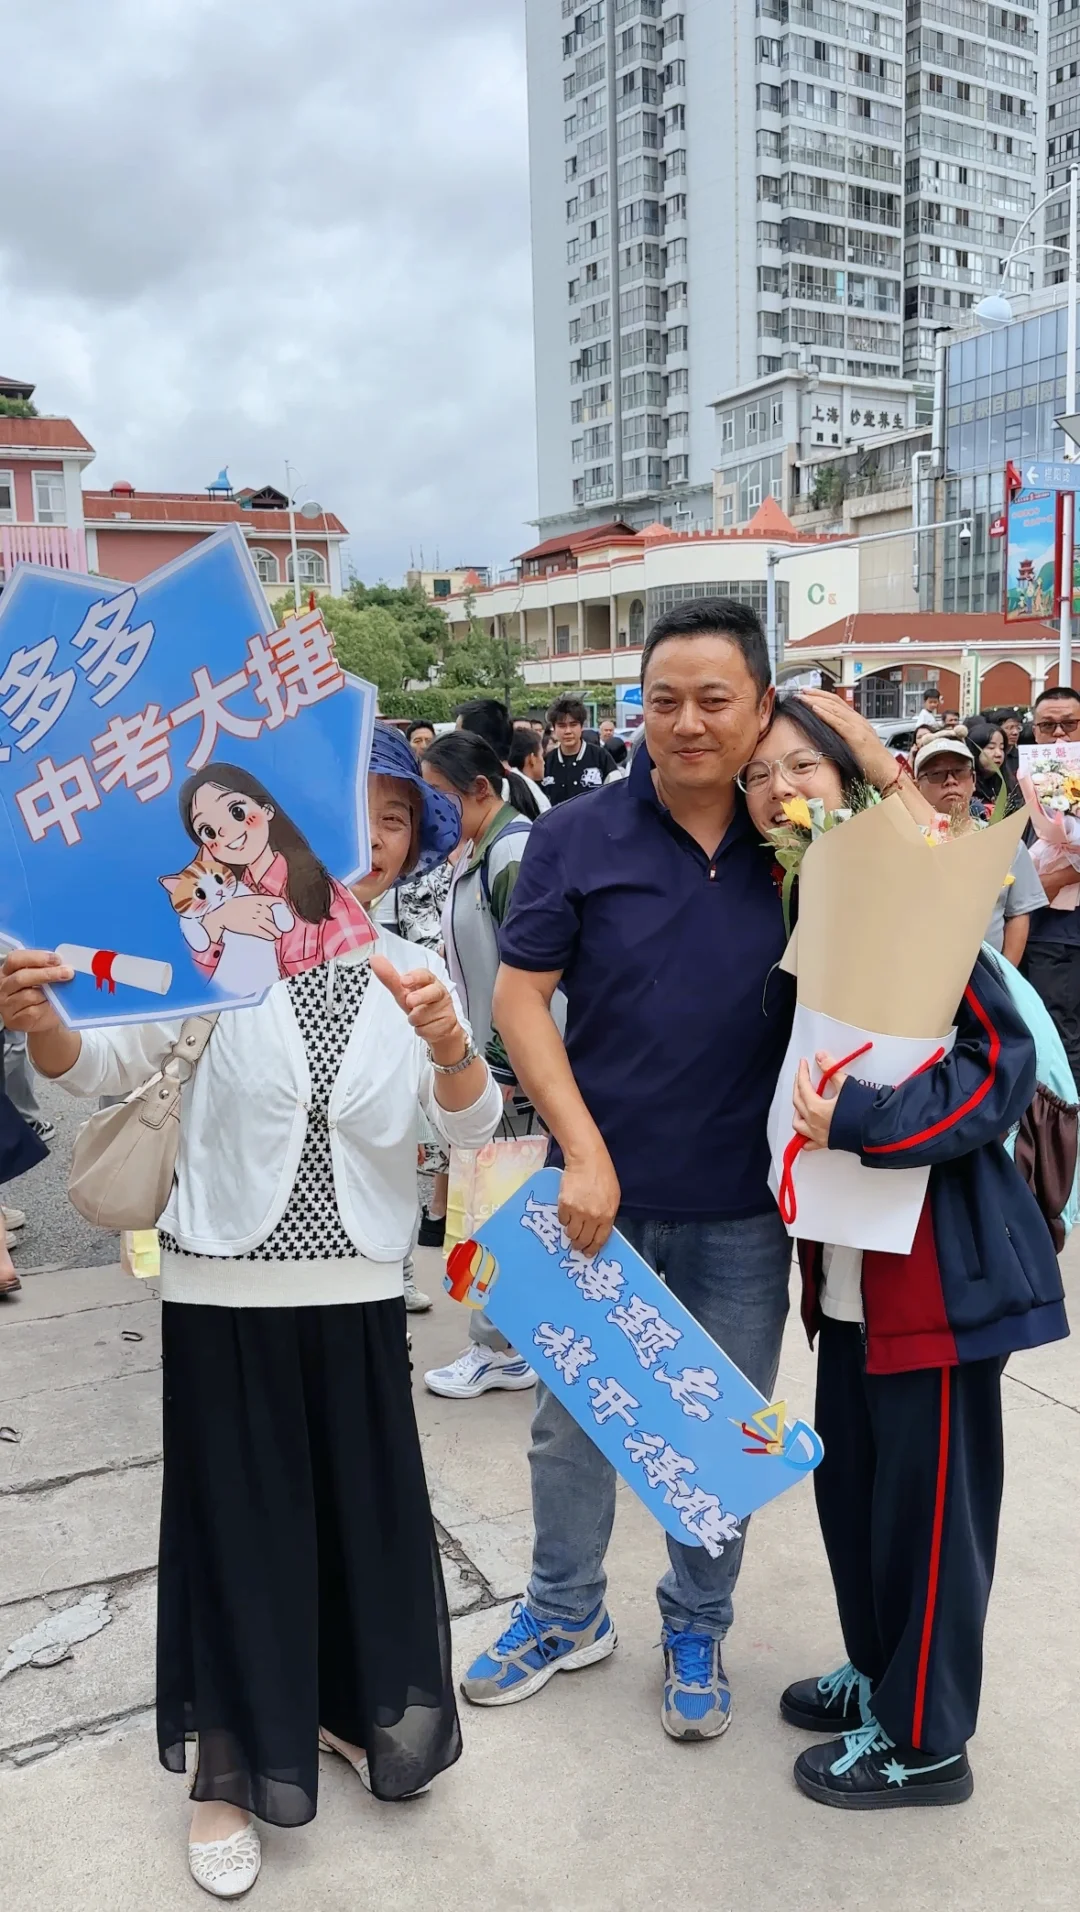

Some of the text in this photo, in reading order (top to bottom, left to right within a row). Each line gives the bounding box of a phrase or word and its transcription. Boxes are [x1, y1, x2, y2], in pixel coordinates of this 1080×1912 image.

[15, 608, 345, 846] 中考大捷
[532, 1321, 742, 1559] 旗开得胜
